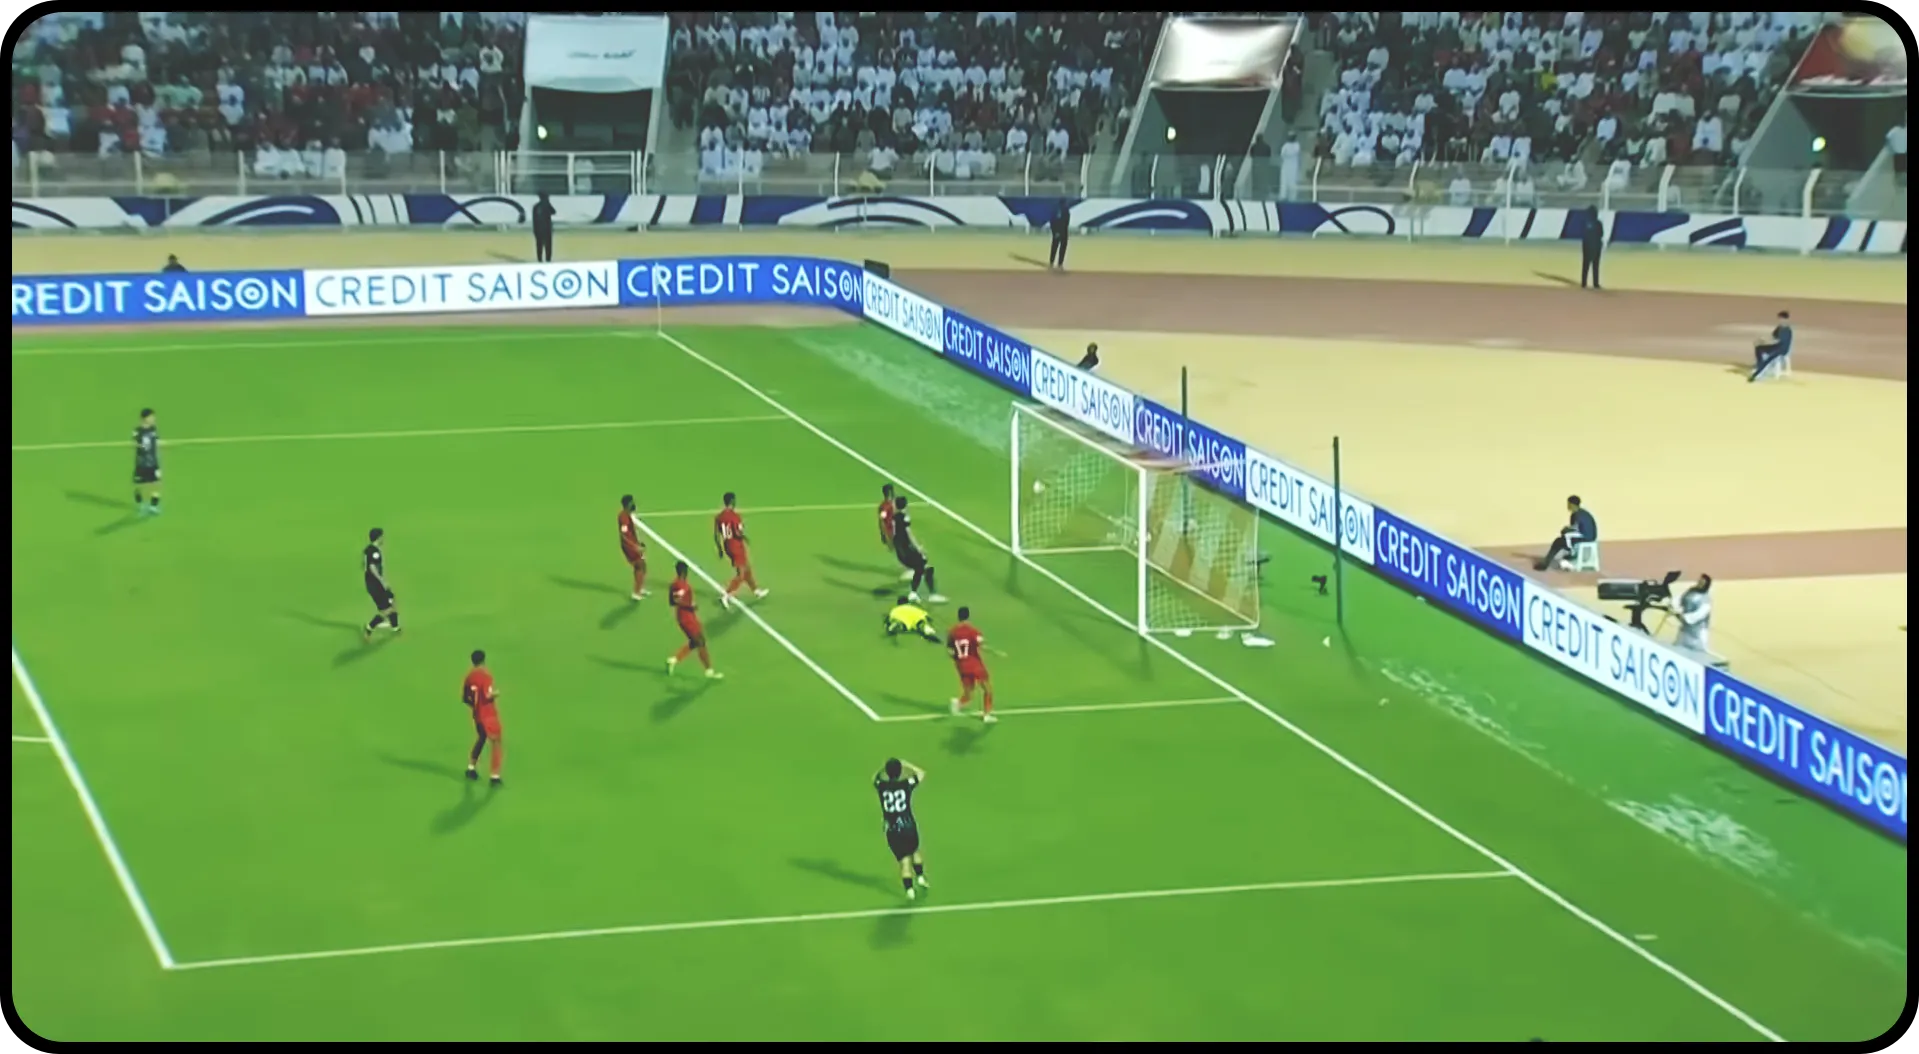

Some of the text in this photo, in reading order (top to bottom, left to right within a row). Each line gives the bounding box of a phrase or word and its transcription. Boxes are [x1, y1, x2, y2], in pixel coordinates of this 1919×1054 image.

[144, 277, 298, 313] SAISON
[316, 268, 609, 308] CREDIT SAISON
[626, 262, 863, 303] CREDIT SAISON
[865, 279, 941, 342] CREDIT SAISON
[944, 316, 1030, 386] CREDIT SAISON
[1034, 359, 1131, 435] CREDIT SAISON
[1135, 405, 1244, 488] CREDIT SAISON
[1250, 459, 1304, 518] CREDIT
[1376, 520, 1521, 630] CREDIT SAISON
[955, 638, 969, 659] 17
[1528, 595, 1699, 718] CREDIT SAISON
[1708, 683, 1803, 769] CREDIT
[882, 789, 907, 813] 22
